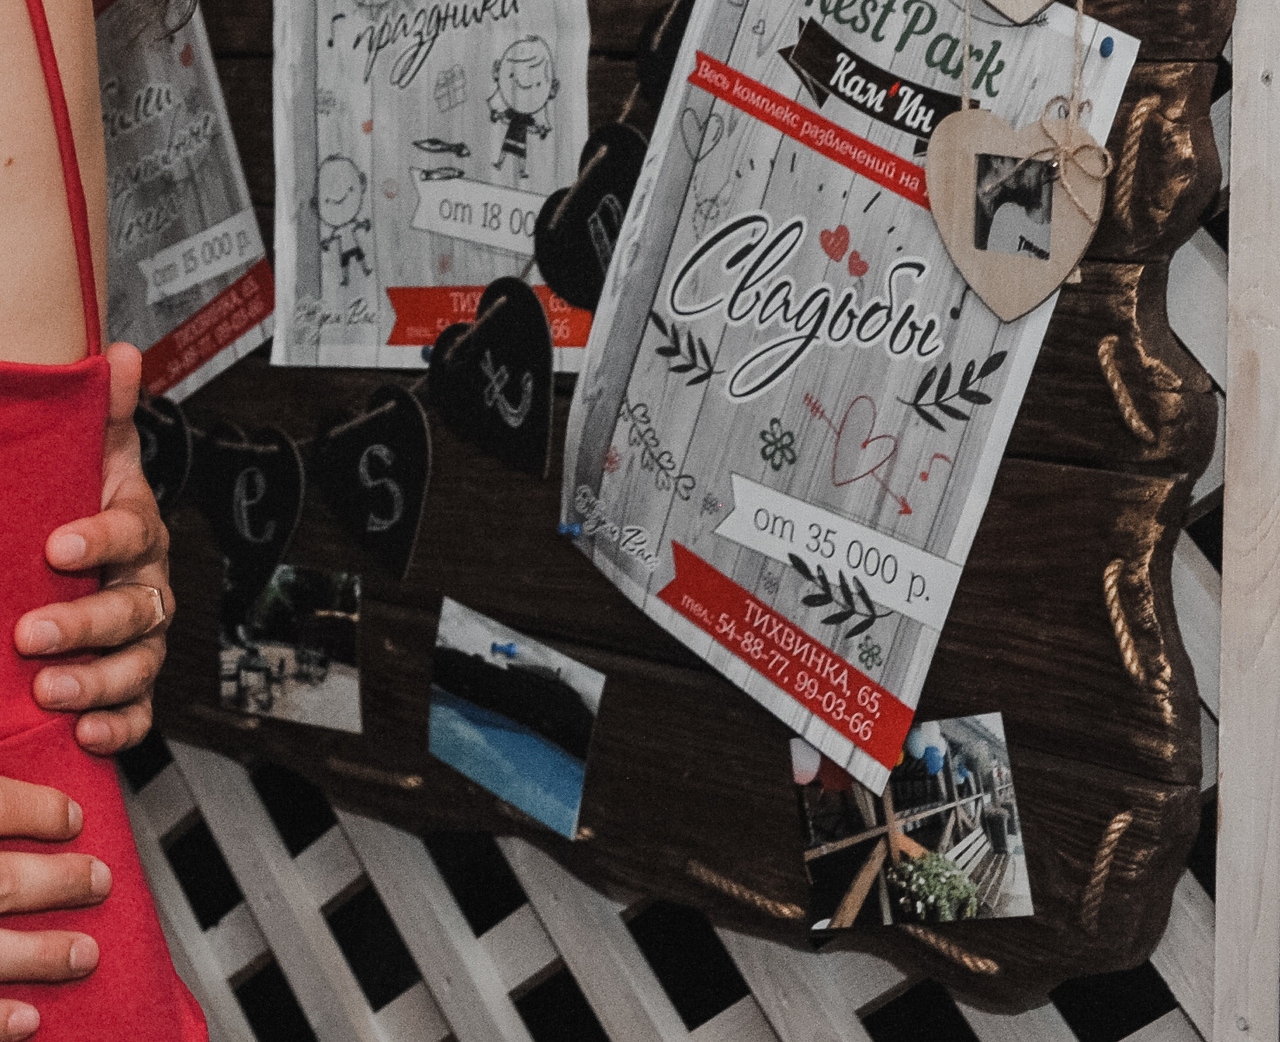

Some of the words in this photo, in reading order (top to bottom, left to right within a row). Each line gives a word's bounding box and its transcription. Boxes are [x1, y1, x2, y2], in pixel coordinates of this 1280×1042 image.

[733, 77, 800, 130] комплекс
[800, 116, 897, 182] развлечений
[899, 171, 921, 192] на
[481, 201, 502, 231] 18
[509, 208, 535, 238] 00
[670, 214, 942, 398] Свадьбы
[753, 507, 797, 542] от
[806, 523, 837, 560] 35
[846, 540, 898, 586] 000
[908, 574, 930, 603] р.
[744, 600, 853, 698] ТИХВИНКА,
[857, 685, 884, 720] 65,
[794, 674, 873, 743] 99-03-66
